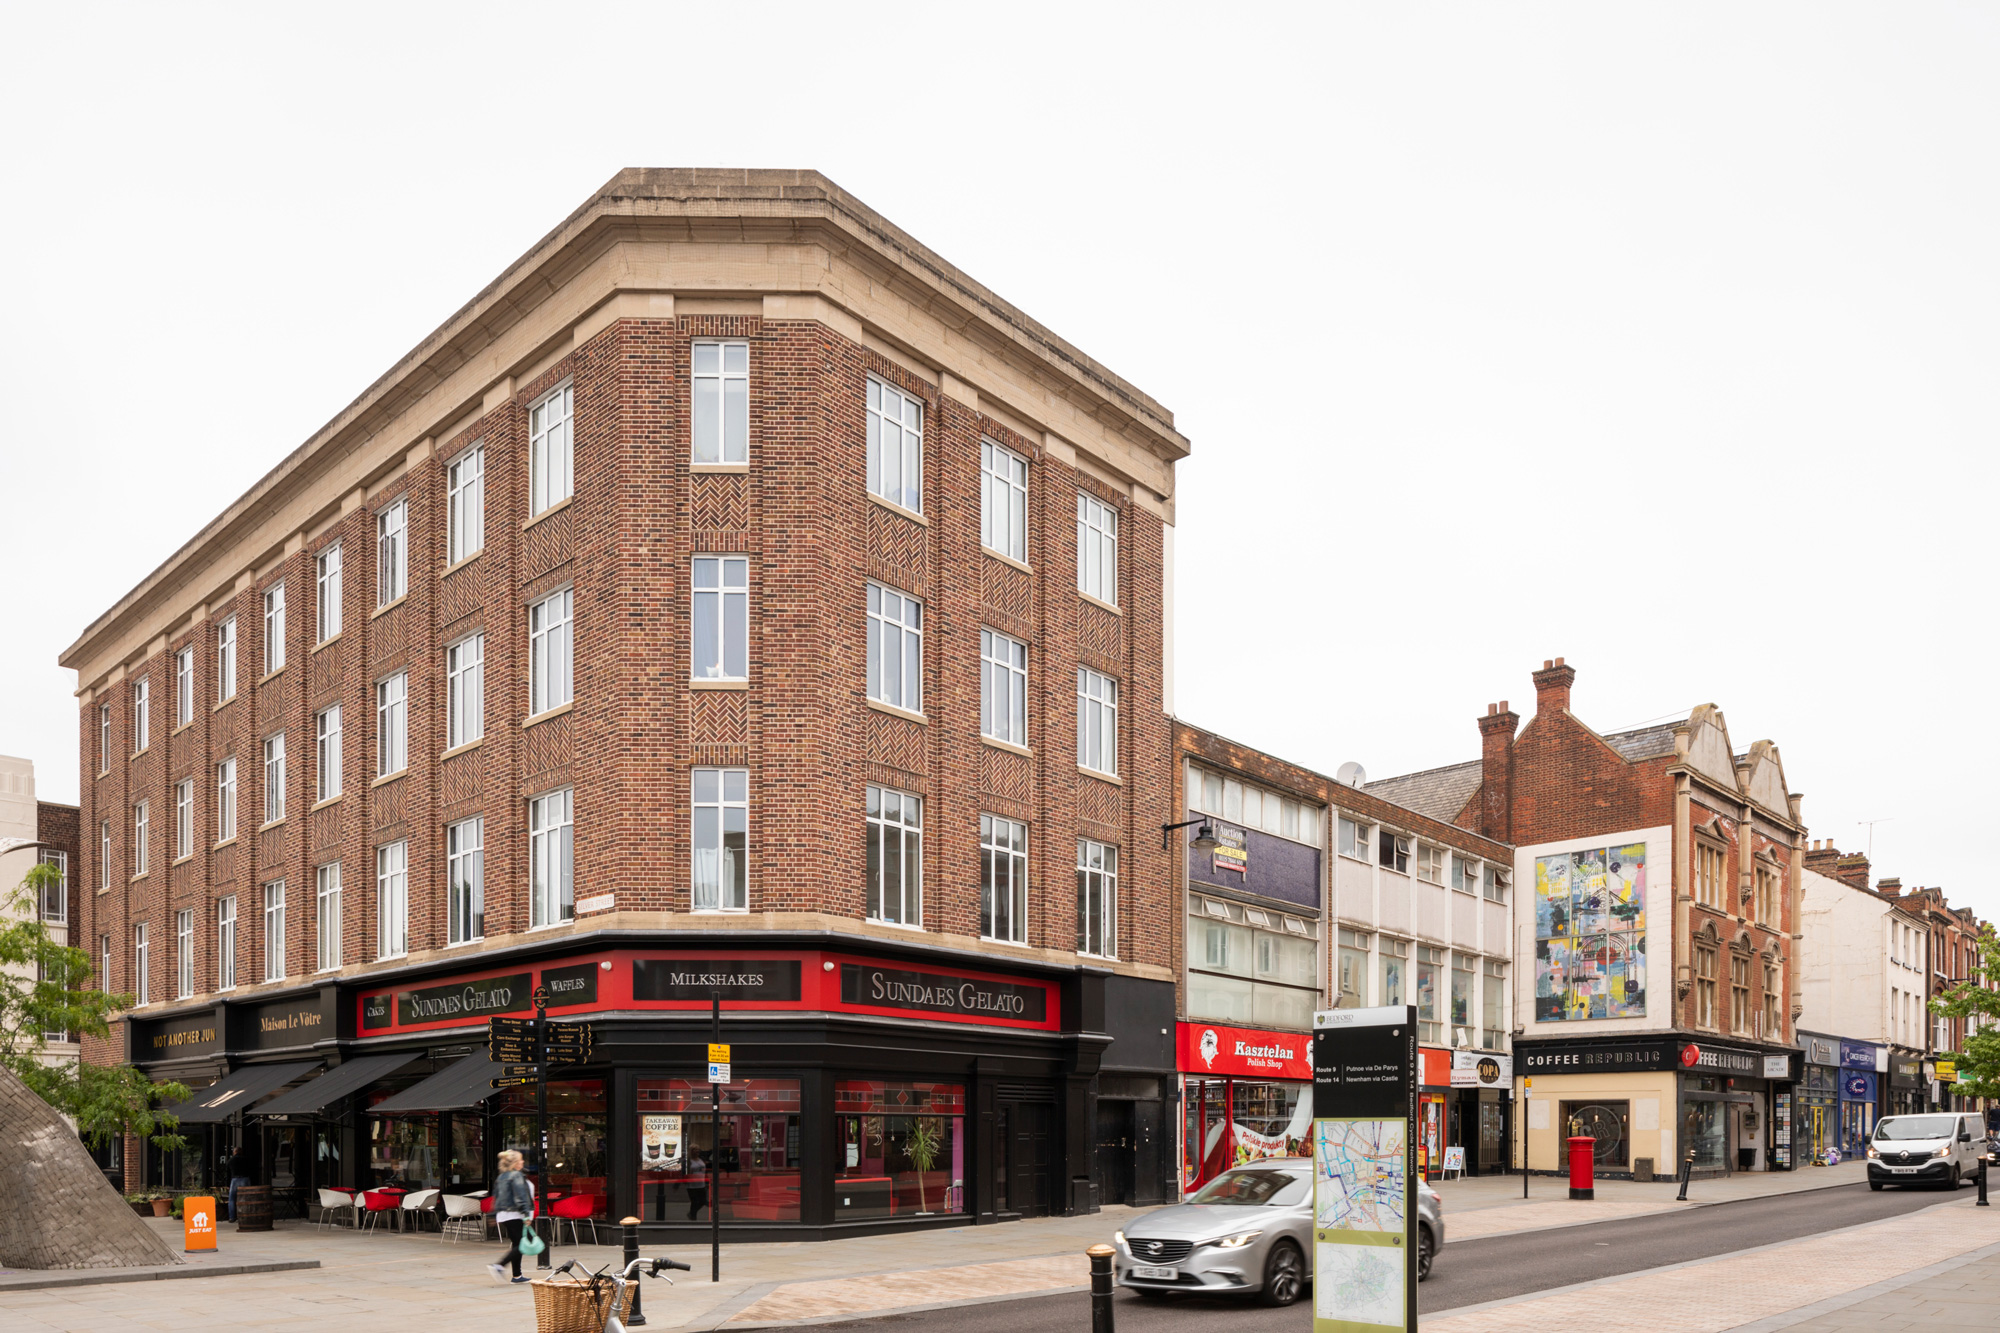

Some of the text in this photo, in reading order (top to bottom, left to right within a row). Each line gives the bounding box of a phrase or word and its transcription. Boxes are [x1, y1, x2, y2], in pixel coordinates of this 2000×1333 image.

[1220, 825, 1243, 841] Auction
[1219, 836, 1236, 848] Estates
[1219, 846, 1243, 858] FOR SALE
[578, 896, 613, 911] SILVER STREET
[550, 978, 584, 992] WAFFLES
[670, 972, 764, 986] MILKSHAKES
[872, 972, 1024, 1014] SUNDAES GELATO
[412, 986, 512, 1018] SUNDAES GELATO
[367, 1006, 385, 1017] CAKES
[260, 1012, 322, 1032] Maison Le Vôtre
[153, 1034, 166, 1048] NOT
[168, 1030, 199, 1046] ANOTHER
[1234, 1041, 1293, 1059] Kasztelan
[1247, 1058, 1283, 1070] Polish Shop
[1528, 1051, 1660, 1066] COFFEE REPUBLIC
[1719, 1053, 1754, 1070] REPUBLIC
[1478, 1064, 1499, 1076] COPA
[1410, 1080, 1414, 1089] 14
[1242, 1131, 1285, 1150] Polskie produkty
